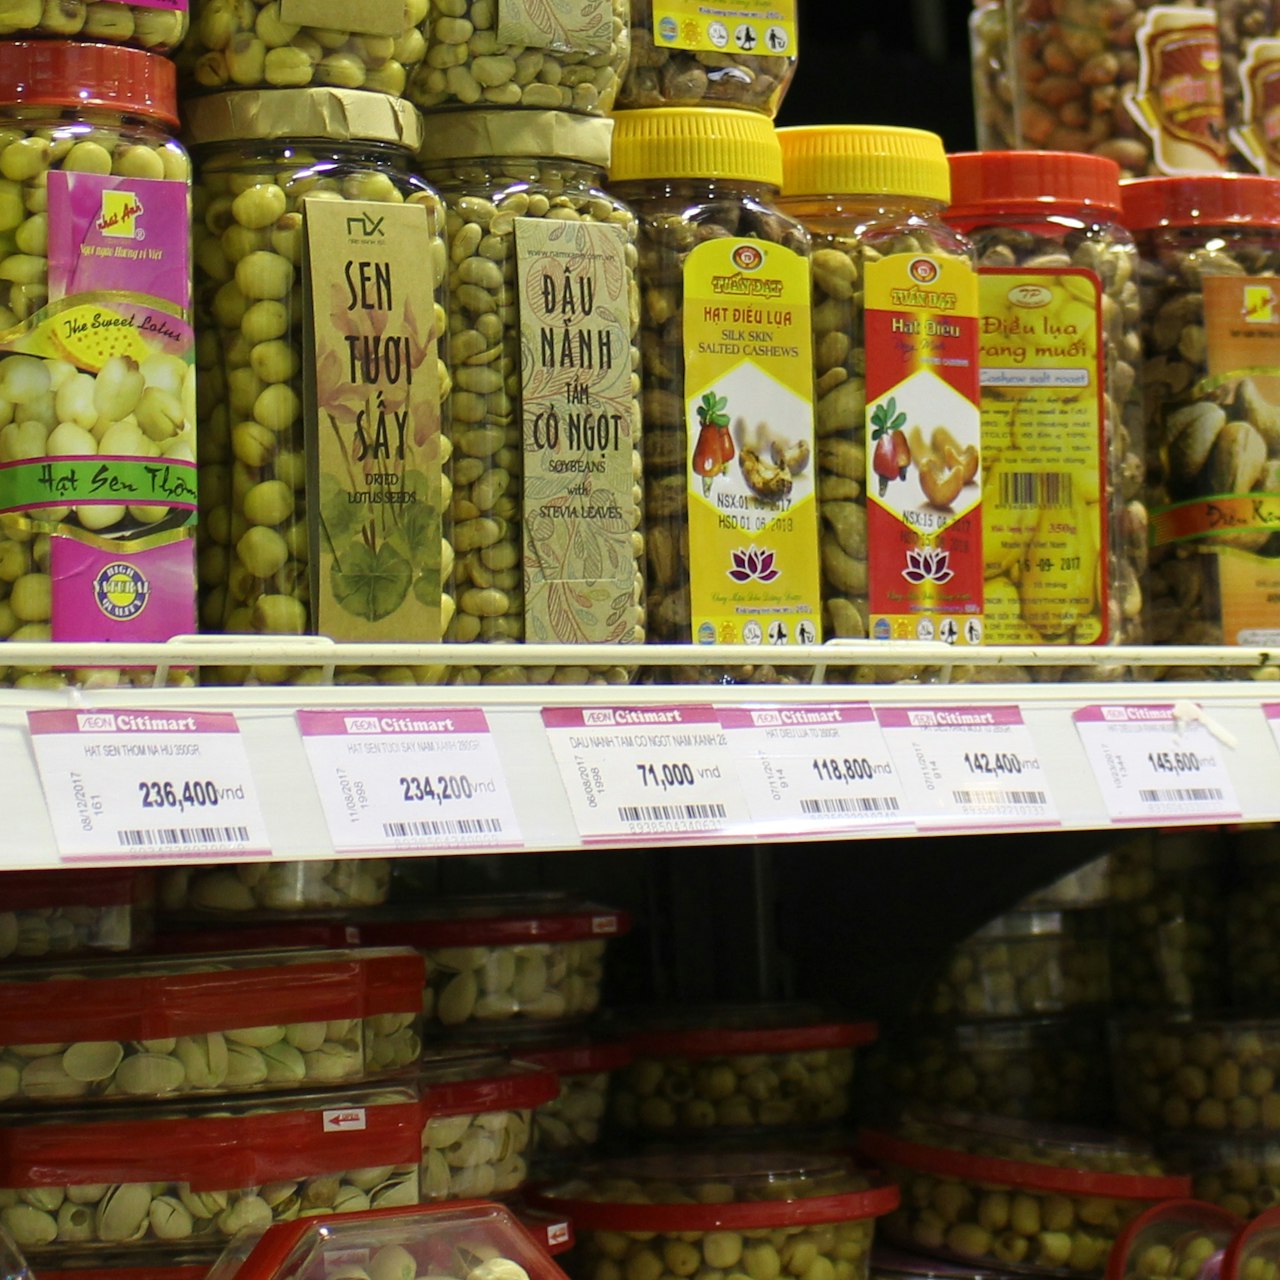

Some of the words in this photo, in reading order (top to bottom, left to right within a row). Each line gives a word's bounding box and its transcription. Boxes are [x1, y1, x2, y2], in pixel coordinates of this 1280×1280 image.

[345, 260, 393, 312] SEN
[704, 307, 728, 325] HẠT
[767, 311, 792, 328] LỤA
[64, 318, 88, 339] The
[91, 313, 135, 328] Sweet
[137, 316, 181, 342] Lotus
[722, 329, 745, 340] SILK
[749, 330, 773, 342] SKIN
[699, 343, 740, 355] SALTED
[743, 345, 799, 357] CASHEWS
[344, 335, 412, 385] TƯƠI
[357, 392, 409, 461] SẤY
[533, 403, 558, 449] CỎ
[568, 414, 621, 459] NGỌT
[548, 459, 606, 474] SOYBEANS
[38, 464, 78, 496] Hạt
[88, 464, 138, 493] Sen
[364, 473, 399, 487] DRIED
[566, 484, 588, 497] with
[347, 491, 382, 505] LOTUS
[384, 492, 416, 505] SEEDS
[539, 505, 579, 519] STEVIA
[581, 505, 622, 519] LEAVES
[117, 716, 196, 730] Citimart
[615, 710, 682, 724] Citimart
[781, 709, 842, 725] Citimart
[936, 712, 995, 726] Citimart
[381, 718, 455, 731] Citimart
[347, 743, 362, 753] HAT
[590, 736, 614, 747] NANH
[615, 736, 633, 746] TAM
[635, 736, 648, 746] CO
[649, 736, 670, 746] NGOT
[673, 735, 691, 746] NAM
[693, 735, 718, 746] XANH
[85, 746, 100, 757] HAT
[104, 746, 119, 757] SEN
[122, 746, 145, 756] THOM
[148, 746, 159, 755] NA
[637, 763, 694, 790] 71,000
[698, 768, 720, 778] vnd
